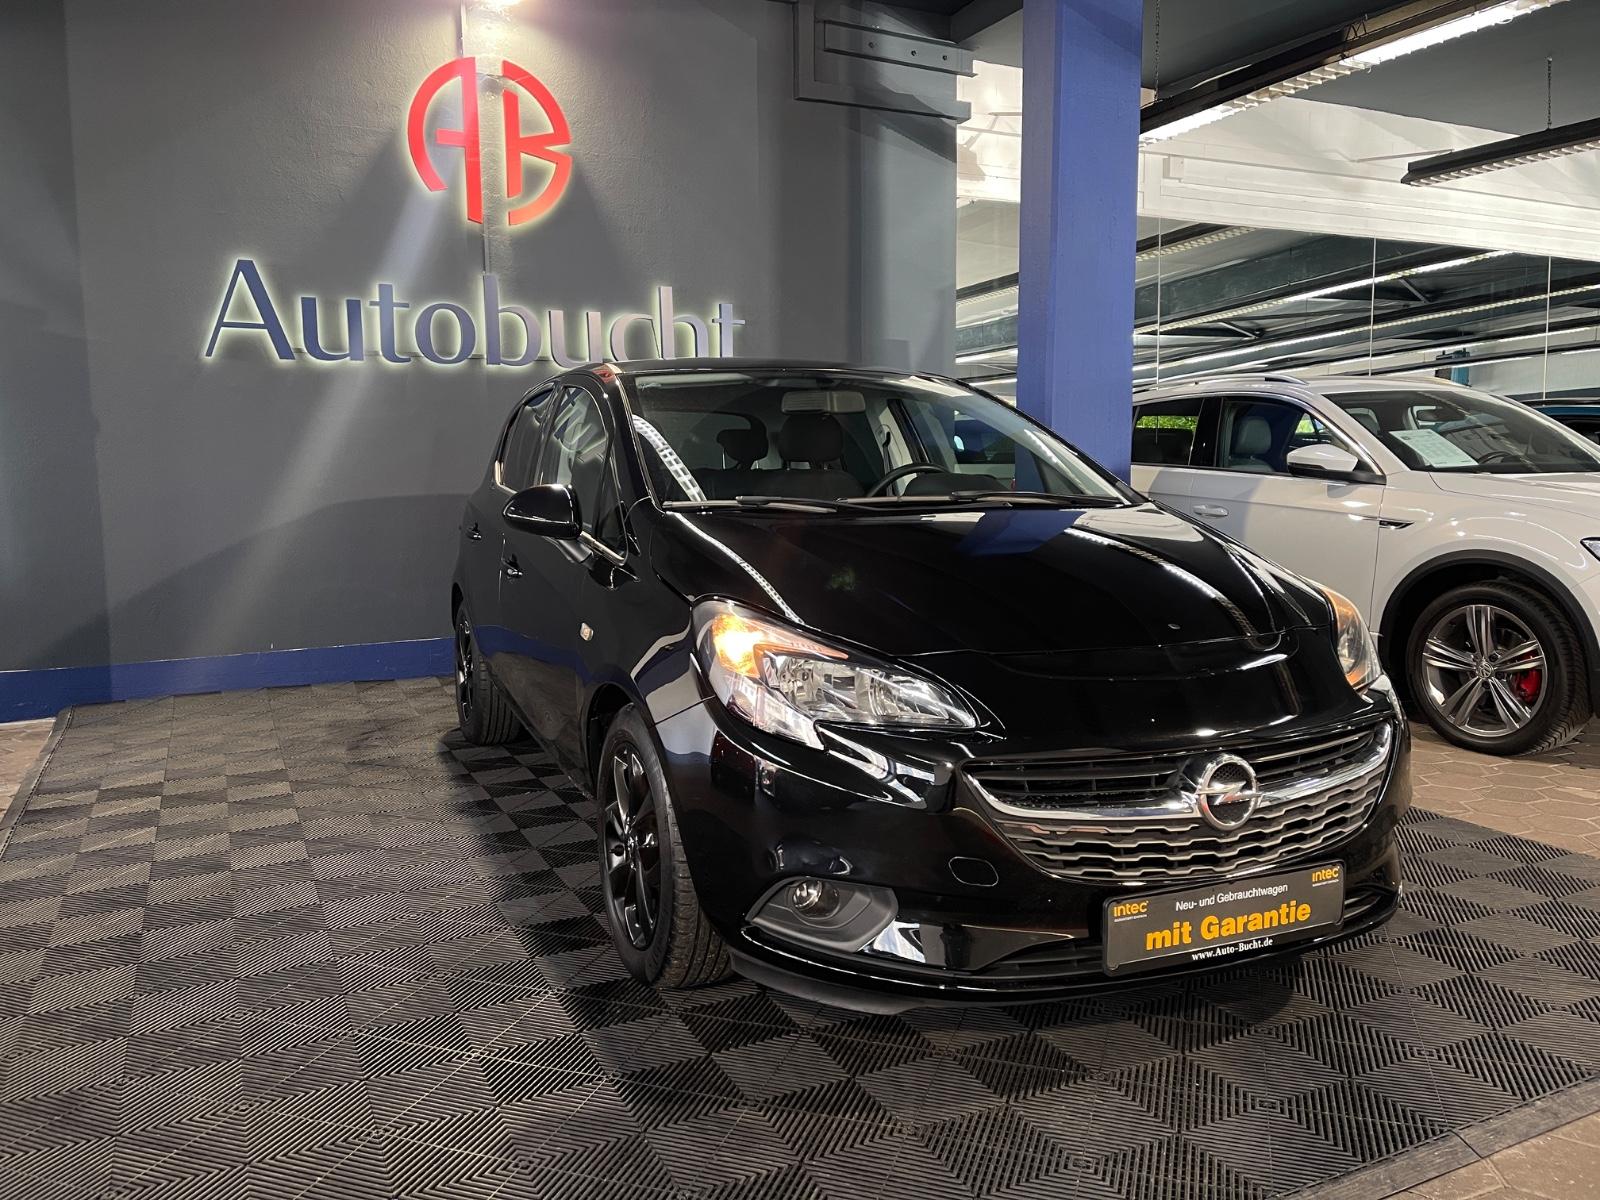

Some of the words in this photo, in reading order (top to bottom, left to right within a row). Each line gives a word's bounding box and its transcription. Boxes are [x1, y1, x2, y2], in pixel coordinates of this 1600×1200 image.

[204, 258, 746, 368] Autobucht
[1312, 868, 1339, 882] intec
[1113, 901, 1148, 917] intec
[1175, 900, 1198, 912] Neu-
[1199, 893, 1215, 907] und
[1216, 884, 1289, 904] Gebrauchtwagen
[1145, 920, 1192, 951] mit
[1200, 900, 1311, 941] Garantie
[1191, 937, 1274, 961] www.Auto-Bucht.de
